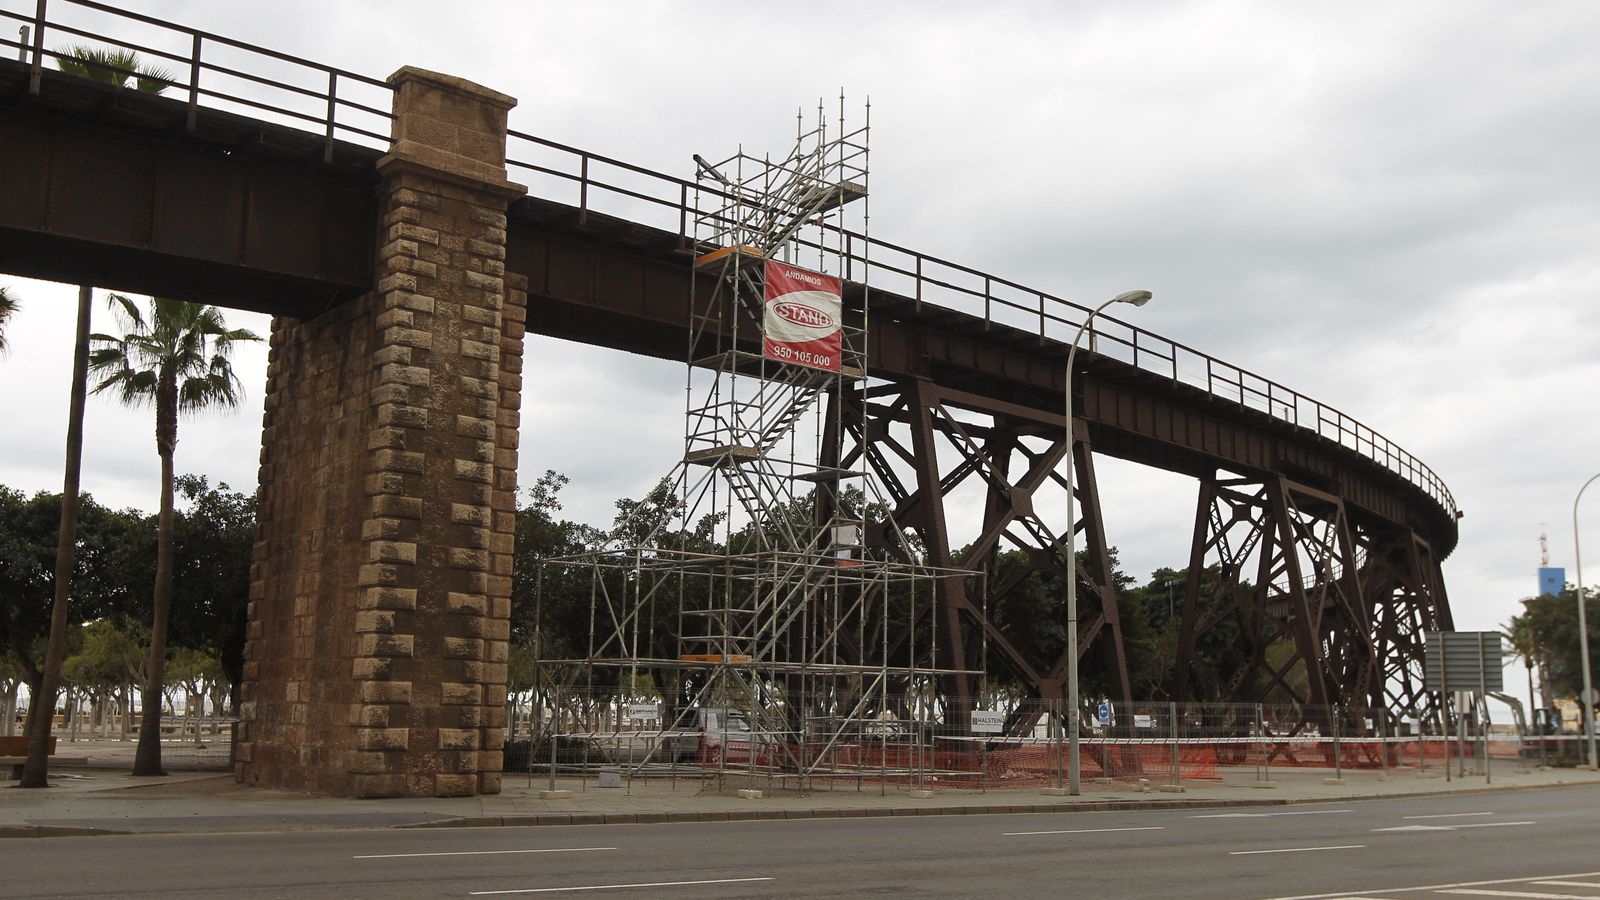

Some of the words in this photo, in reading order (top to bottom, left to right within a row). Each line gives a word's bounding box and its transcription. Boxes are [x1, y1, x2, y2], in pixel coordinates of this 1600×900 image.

[785, 270, 822, 286] ANDAMIOS
[779, 303, 830, 326] STAND
[774, 345, 792, 359] 950
[794, 350, 812, 363] 105
[813, 354, 830, 366] 000
